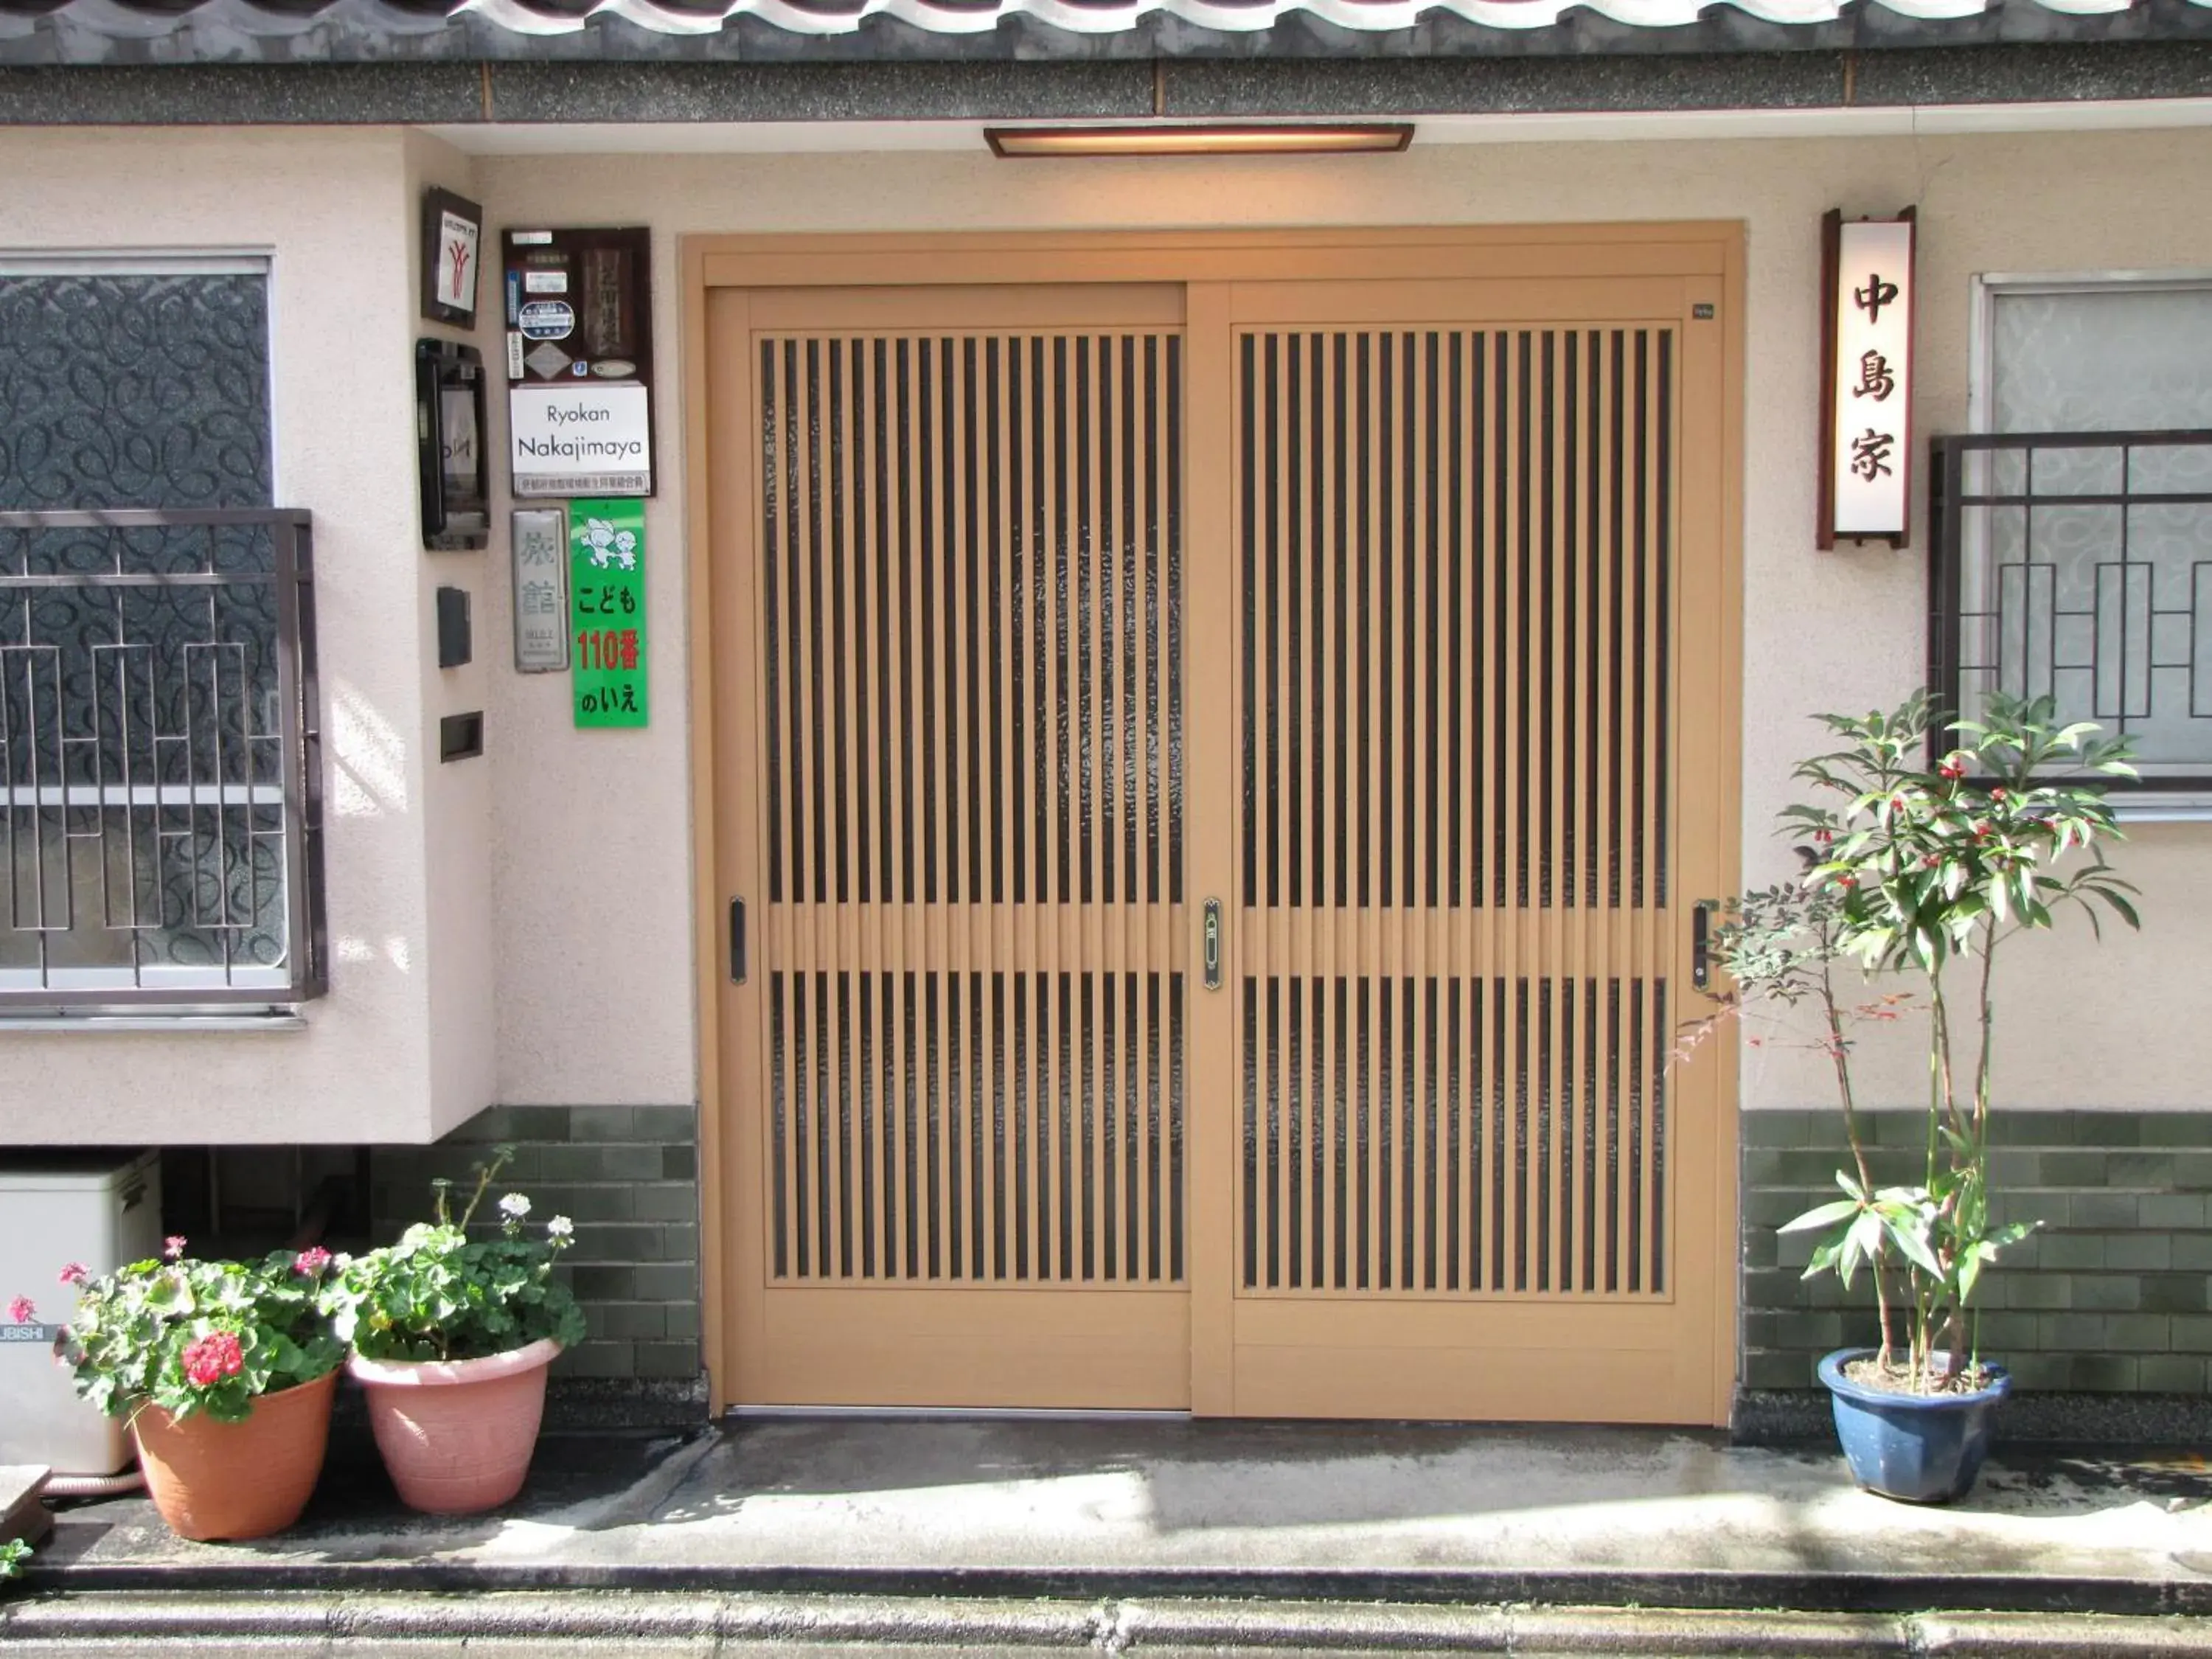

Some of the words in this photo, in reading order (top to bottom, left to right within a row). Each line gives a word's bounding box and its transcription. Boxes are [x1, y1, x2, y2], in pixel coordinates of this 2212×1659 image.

[1850, 273, 1899, 484] 中島家
[547, 402, 610, 426] Ryokan
[518, 434, 641, 462] Nakajimaya
[579, 586, 636, 613] こども
[578, 629, 639, 670] 110番
[582, 684, 638, 713] のいえ
